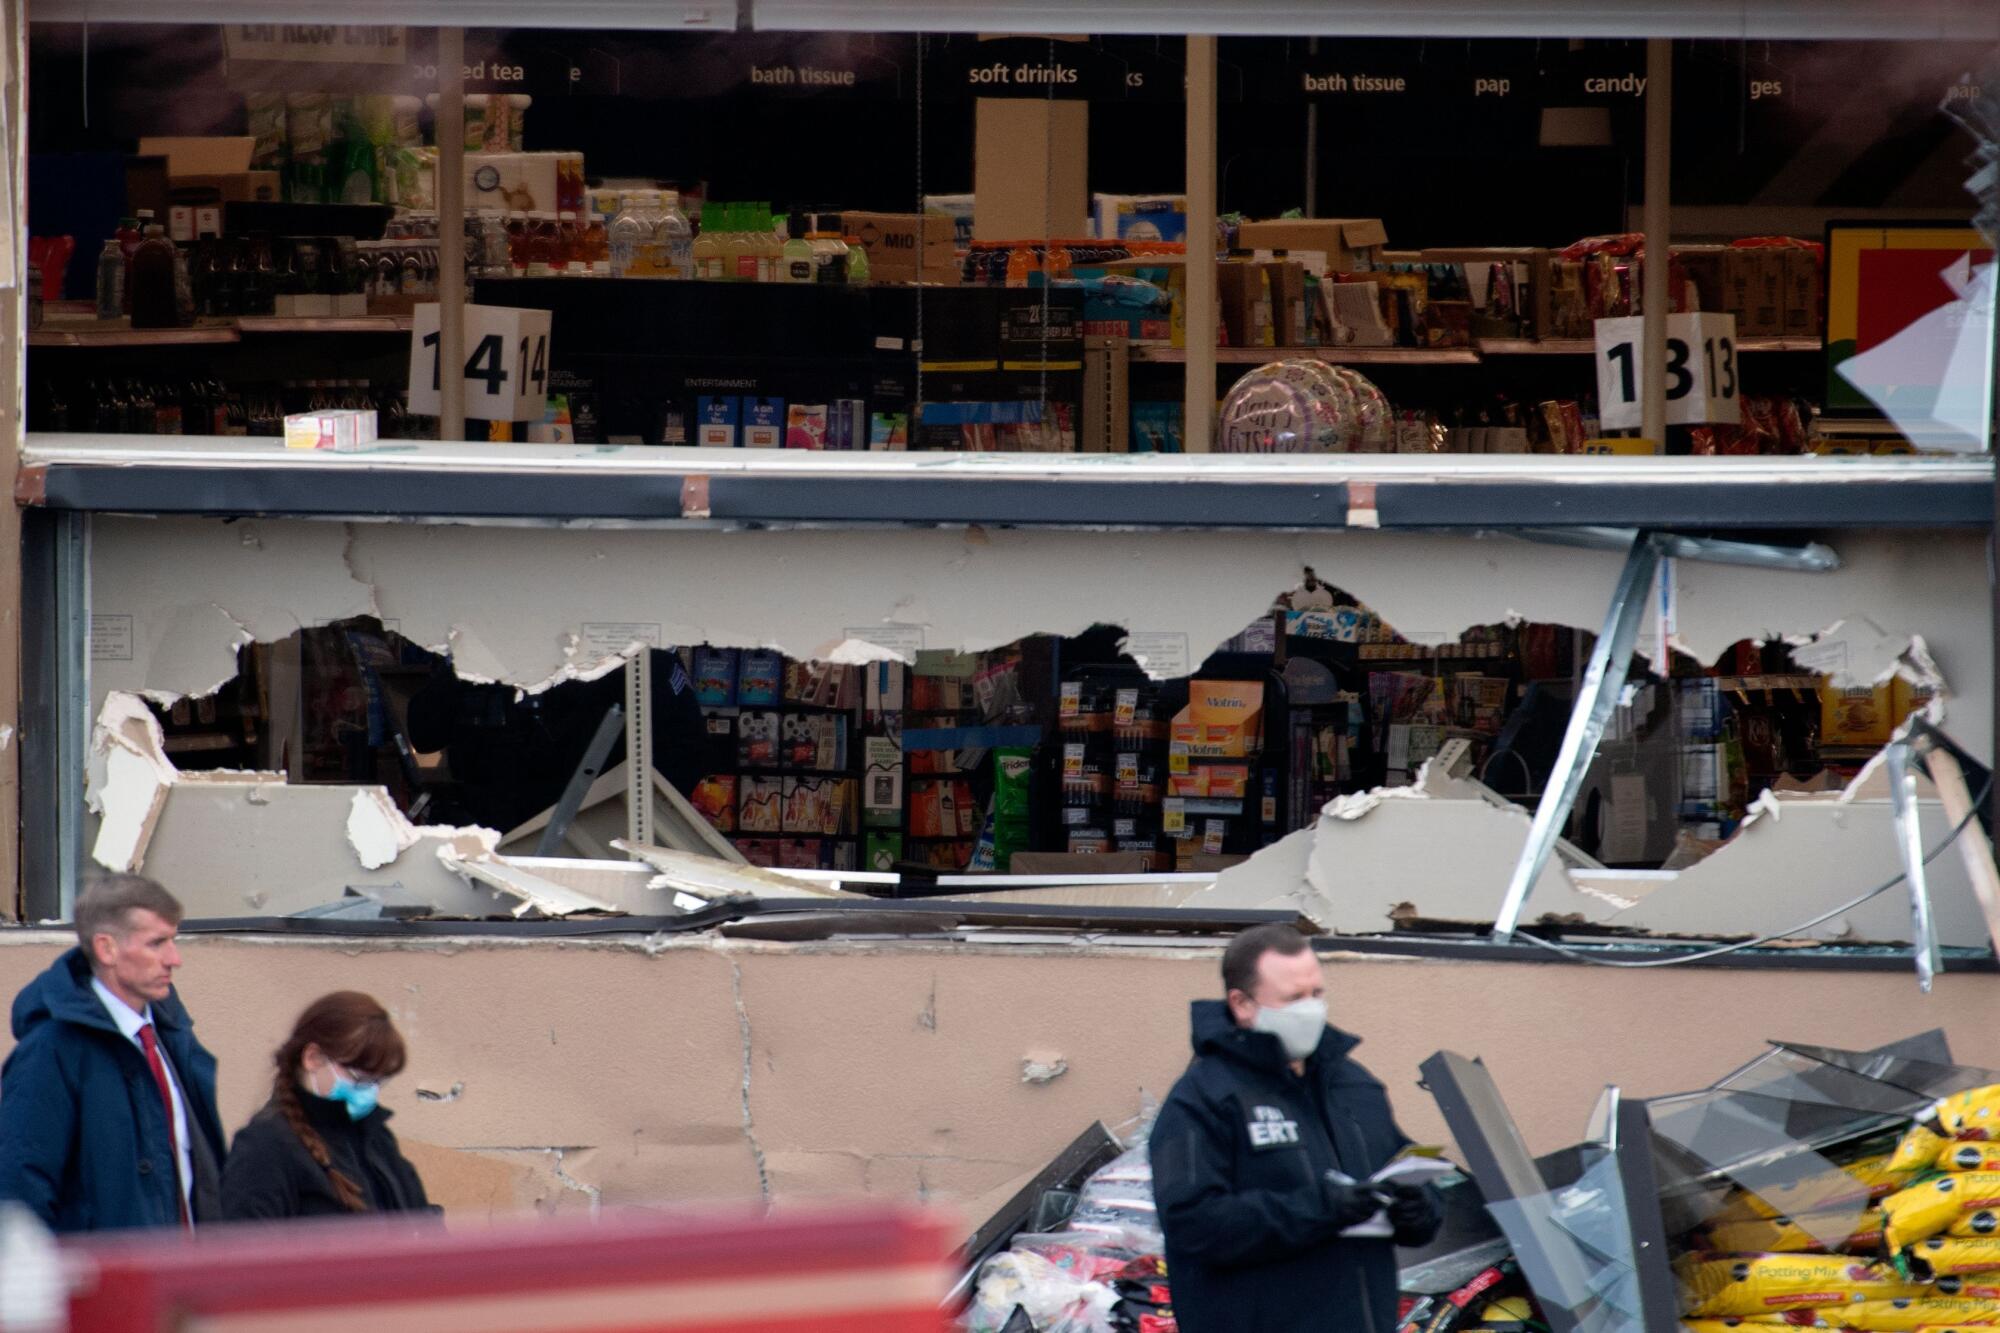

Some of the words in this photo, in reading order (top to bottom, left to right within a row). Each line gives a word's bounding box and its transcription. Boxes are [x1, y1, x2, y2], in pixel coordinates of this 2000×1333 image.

[490, 63, 525, 81] tea
[750, 65, 795, 86] bath
[799, 66, 856, 87] tissue
[967, 64, 1010, 85] soft
[1014, 64, 1079, 84] drinks
[1304, 73, 1348, 92] bath
[1351, 74, 1407, 92] tissue
[1583, 74, 1648, 97] candy
[519, 334, 547, 396] 14
[1607, 338, 1693, 402] 13
[1704, 337, 1735, 399] 13
[1206, 696, 1243, 709] Motrin
[1247, 1120, 1299, 1146] ERT
[1758, 1265, 1811, 1280] Potting
[1813, 1265, 1839, 1278] Mix
